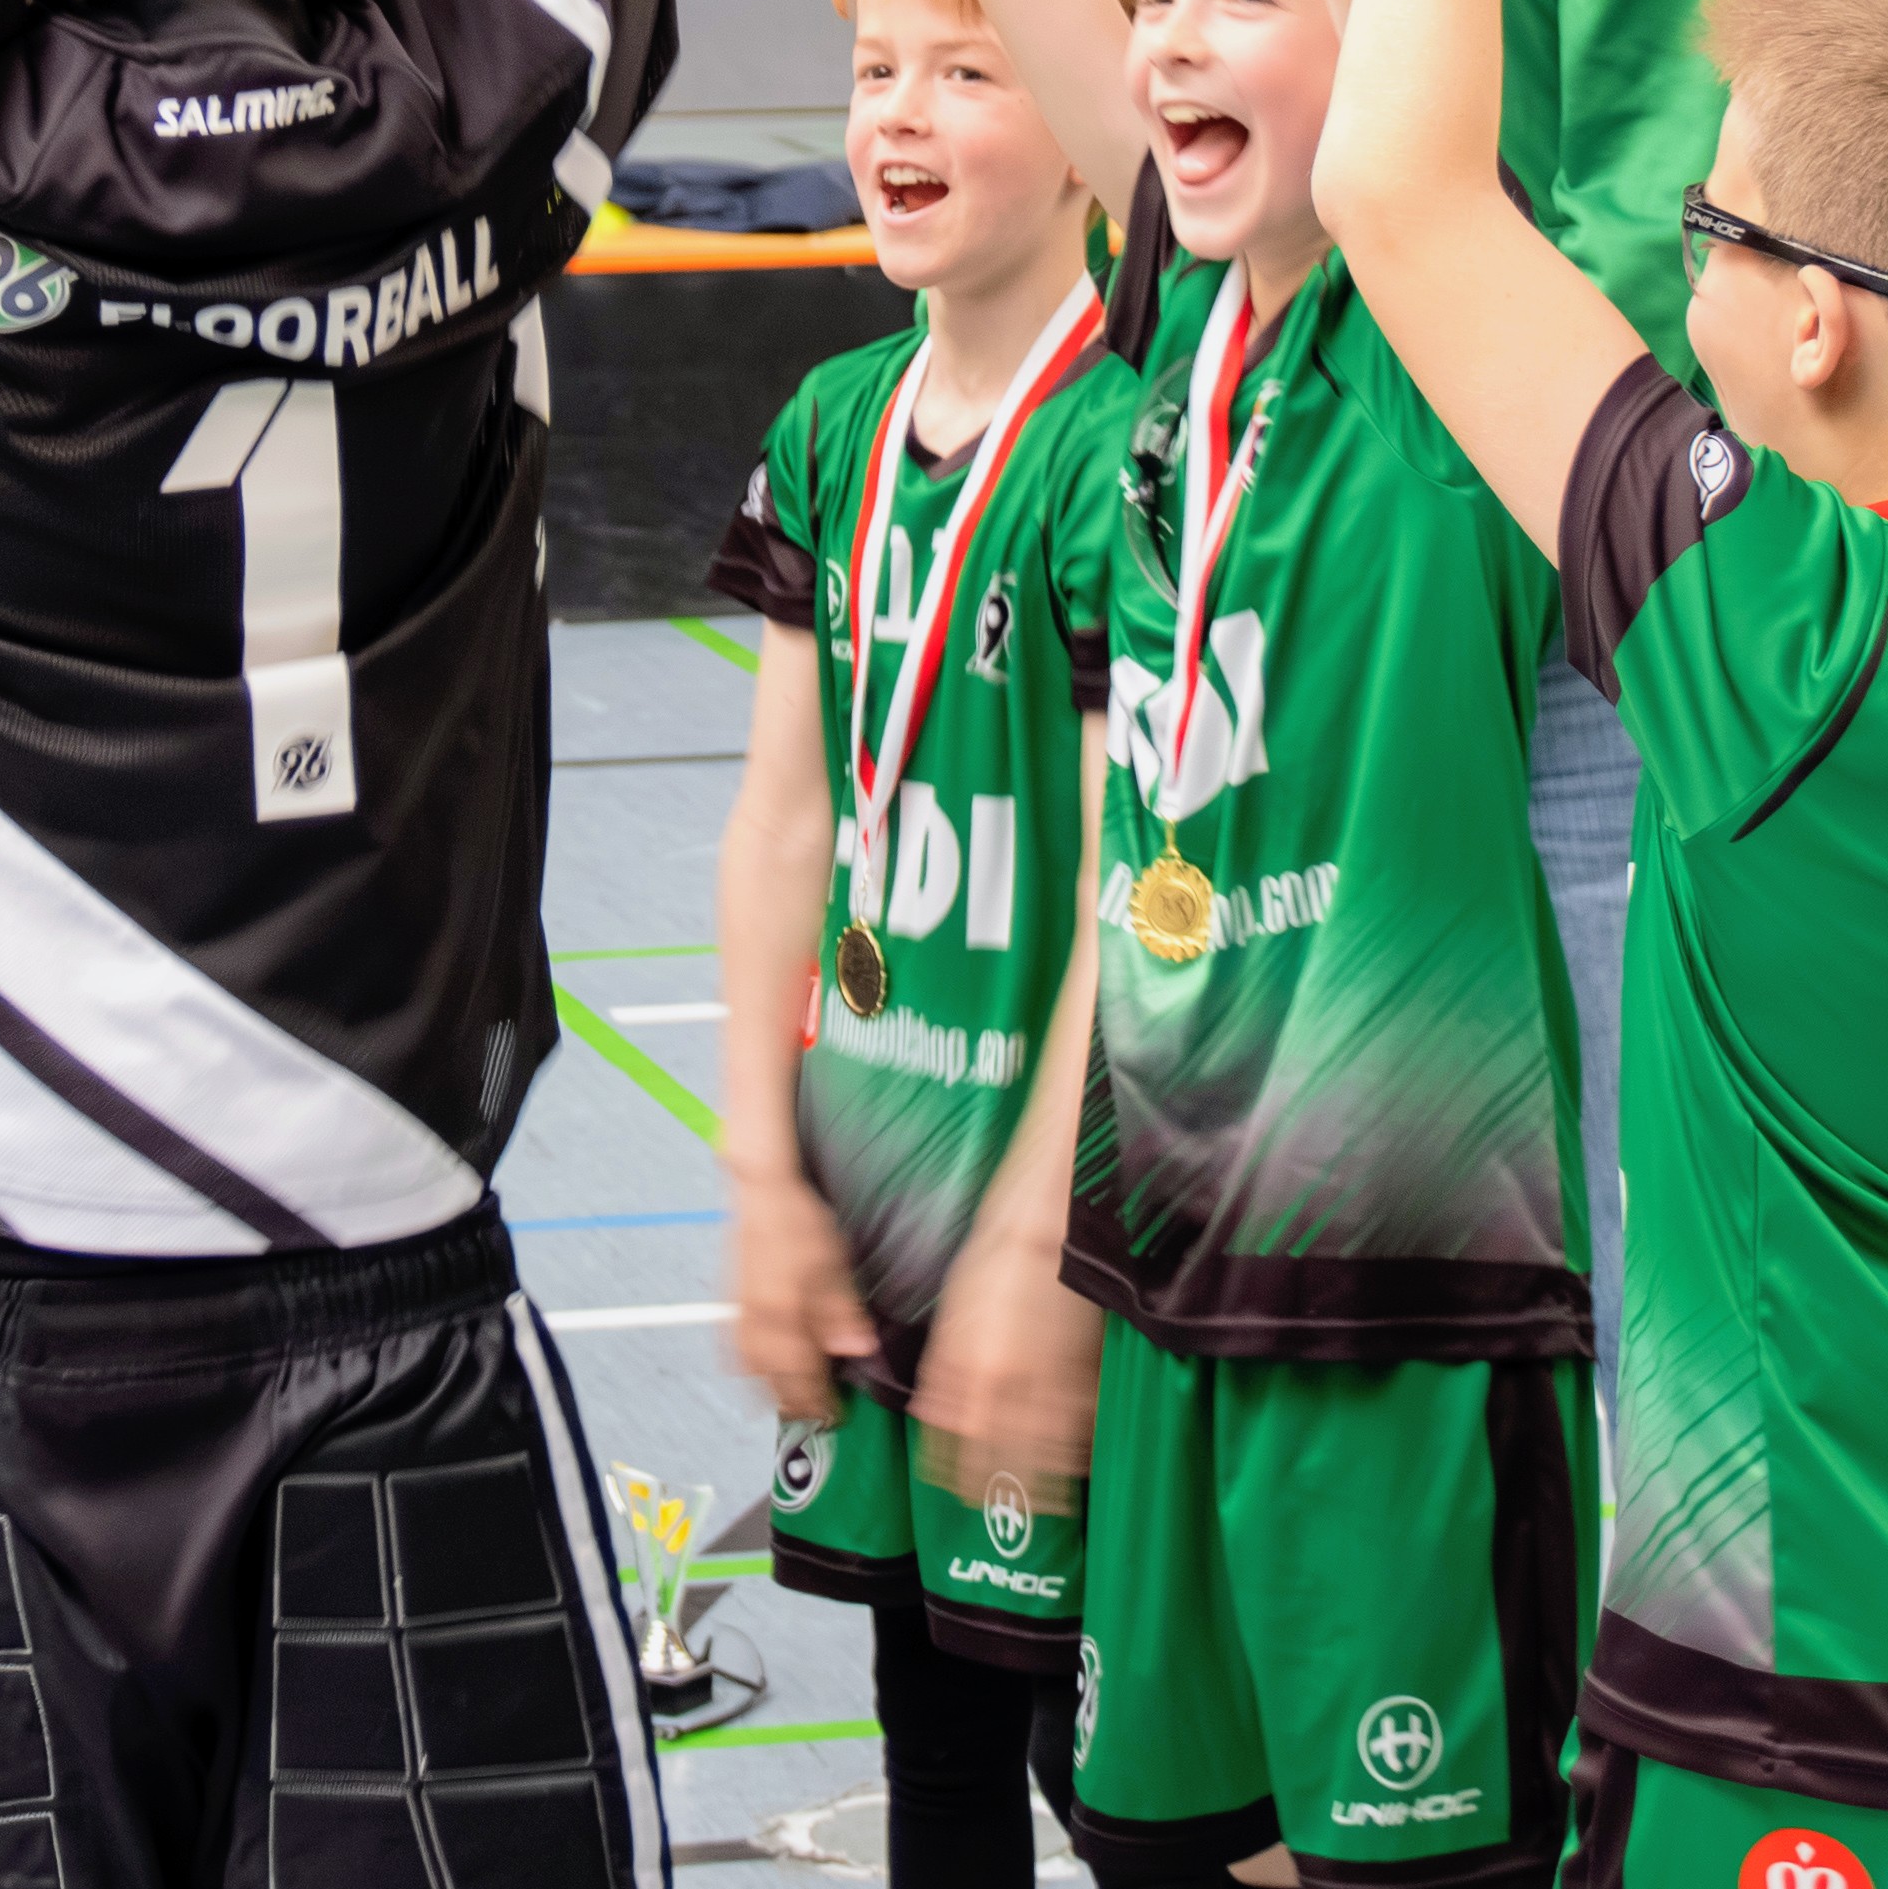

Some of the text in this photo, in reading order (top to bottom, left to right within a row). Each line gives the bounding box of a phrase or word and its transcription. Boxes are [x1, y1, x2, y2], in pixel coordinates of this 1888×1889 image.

[1684, 208, 1746, 240] UNIHOC
[161, 378, 356, 823] 1
[273, 732, 333, 794] 96
[949, 1557, 1065, 1600] UNIHOC
